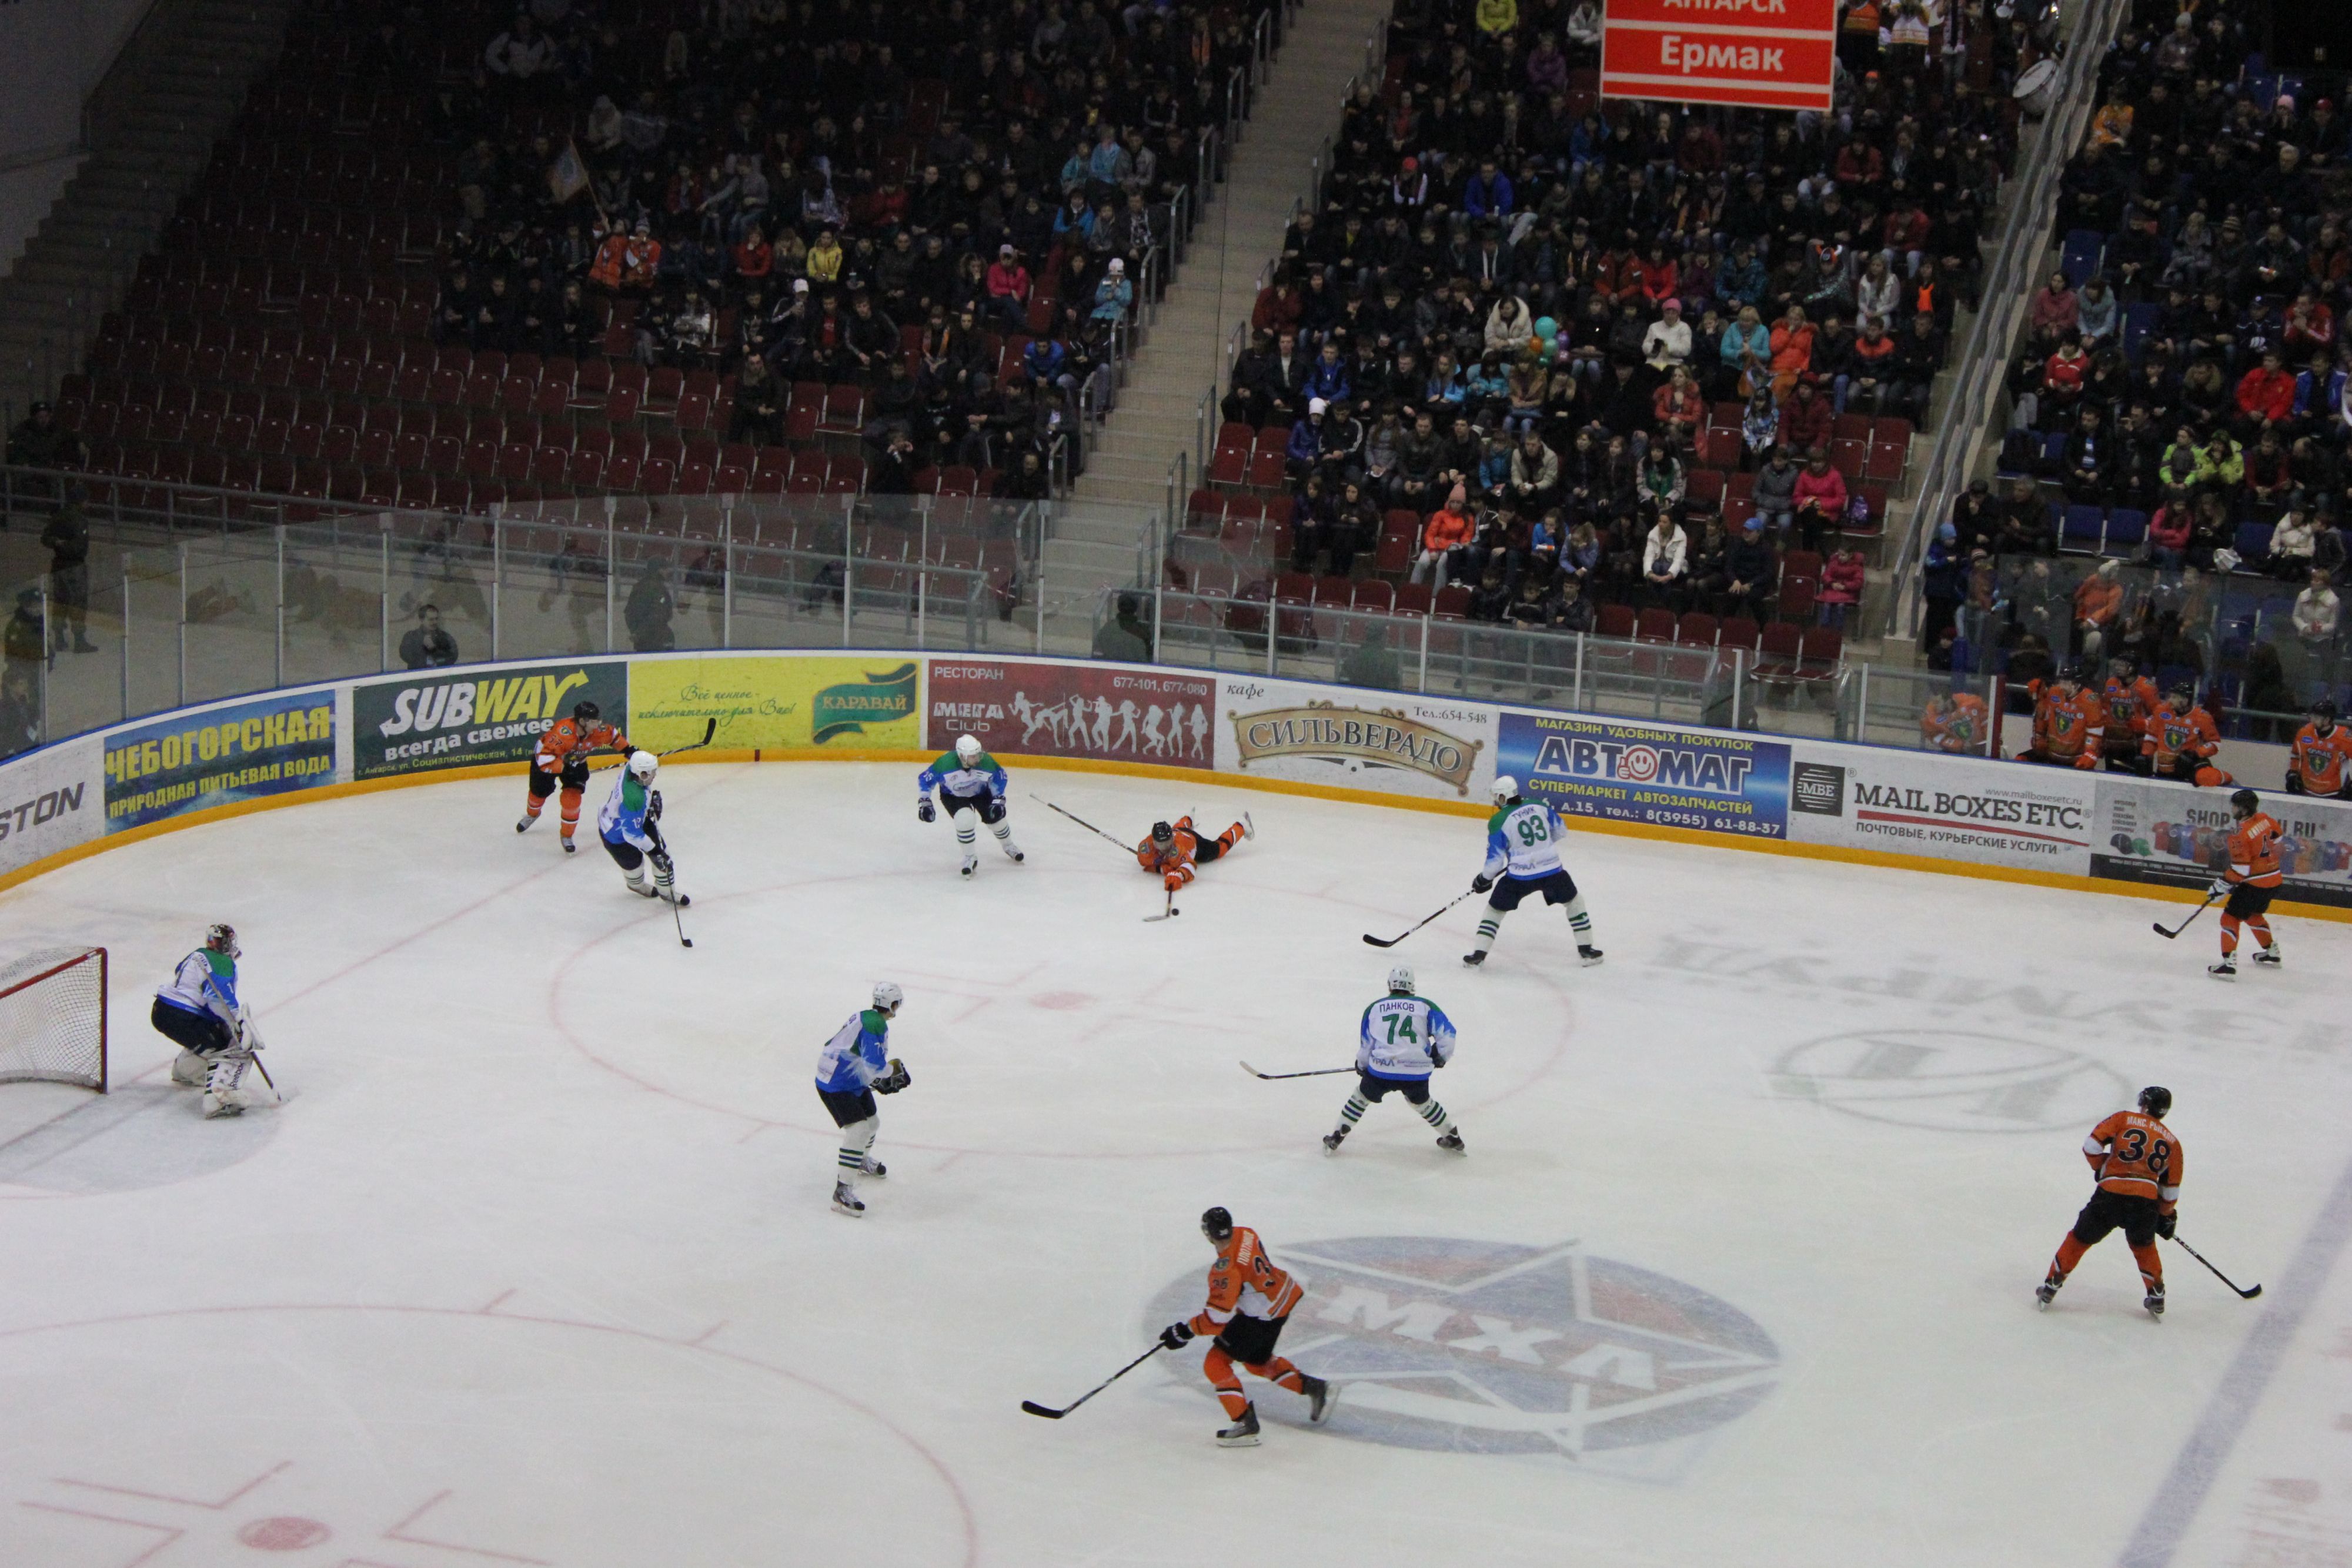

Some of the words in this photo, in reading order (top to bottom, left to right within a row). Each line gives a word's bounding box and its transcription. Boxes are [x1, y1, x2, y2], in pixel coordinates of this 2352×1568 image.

[1661, 35, 1784, 73] Ермак
[934, 667, 1004, 680] РЕСТОРАН
[1114, 677, 1161, 693] 677-101,
[1163, 681, 1207, 696] 677-080
[380, 669, 589, 737] SUBWAY
[681, 683, 710, 701] Всё
[823, 694, 906, 710] КАРАВАЙ
[1227, 684, 1265, 701] кафе
[639, 701, 728, 719] исключительно
[719, 706, 753, 727] для
[760, 698, 796, 716] Вас!
[946, 720, 990, 732] Club
[1414, 706, 1487, 724] Тел.:654-548
[106, 706, 330, 783] ЧЕБОГОРСКАЯ
[385, 734, 462, 762] всегда
[467, 718, 554, 744] свежее
[1248, 719, 1462, 773] СИЛЬВЕРАДО
[1536, 717, 1602, 734] МАГАЗИН
[1607, 725, 1676, 744] УДОБНЫХ
[1682, 734, 1753, 751] ПОКУПОК
[412, 752, 508, 768] Социалистическая,
[512, 747, 523, 756] 14
[109, 778, 196, 819] ПРИРОДНАЯ
[199, 763, 279, 795] ПИТЬЕВАЯ
[284, 755, 330, 779] ВОДА
[1529, 779, 1628, 800] СУПЕРМАРКЕТ
[1633, 791, 1753, 815] АВТОЗАПЧАСТЕЙ
[1802, 781, 1835, 797] MBE
[1985, 788, 2083, 805] www.mailboxesetc.ru
[1512, 805, 1536, 820] ТУНИК
[1561, 801, 1599, 816] д.15,
[1605, 806, 1639, 820] тел.:
[1646, 811, 1708, 830] 8(3955)
[1714, 818, 1780, 835] 61-88-37
[1855, 783, 1929, 813] MAIL
[1933, 793, 2022, 823] BOXES
[2026, 803, 2083, 830] ETC.
[1518, 815, 1548, 847] 93
[1856, 823, 1927, 841] ПОЧТОВЫЕ,
[1930, 831, 2007, 850] КУРЬЕРСКИЕ
[2010, 838, 2057, 854] УСЛУГИ
[1379, 1002, 1415, 1012] ПАНКОВ
[1382, 1014, 1417, 1045] 74
[2118, 1128, 2171, 1173] 38
[1315, 1285, 1657, 1392] МХЛ
